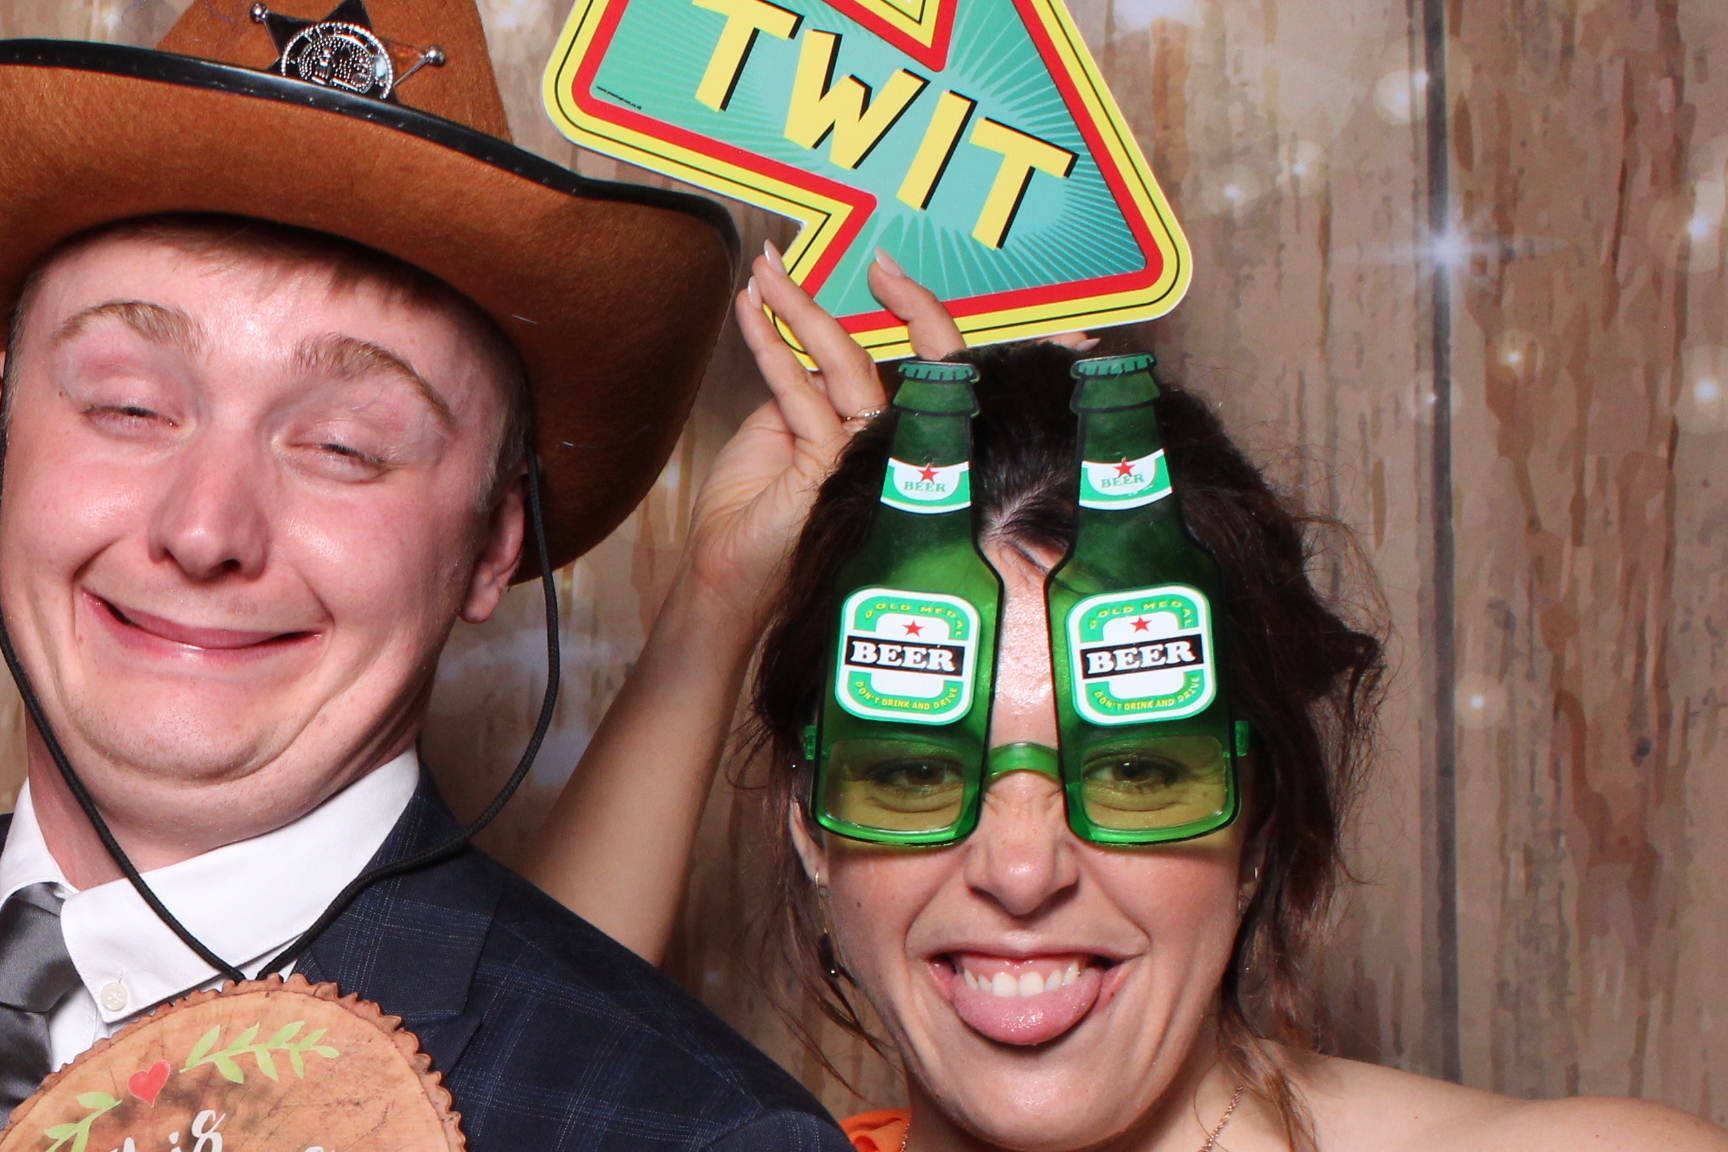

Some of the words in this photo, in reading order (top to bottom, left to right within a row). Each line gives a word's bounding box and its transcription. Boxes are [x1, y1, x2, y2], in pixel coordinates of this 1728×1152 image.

[691, 0, 1080, 251] TWIT
[903, 481, 946, 492] BEER
[1101, 474, 1144, 488] BEER
[864, 602, 911, 619] GOLD
[919, 606, 964, 637] MEDAL
[1089, 605, 1134, 629] GOLD
[1143, 600, 1192, 627] MEDAL
[850, 641, 955, 672] BEER
[1086, 641, 1196, 675] BEER
[855, 680, 879, 704] DON'T
[881, 698, 910, 708] DRINK
[912, 700, 930, 711] AND
[933, 687, 958, 709] DRIVE
[1094, 690, 1122, 710] DON'T
[1124, 700, 1154, 711] DRINK
[1155, 697, 1175, 708] AND
[1177, 676, 1200, 703] DRIVE
